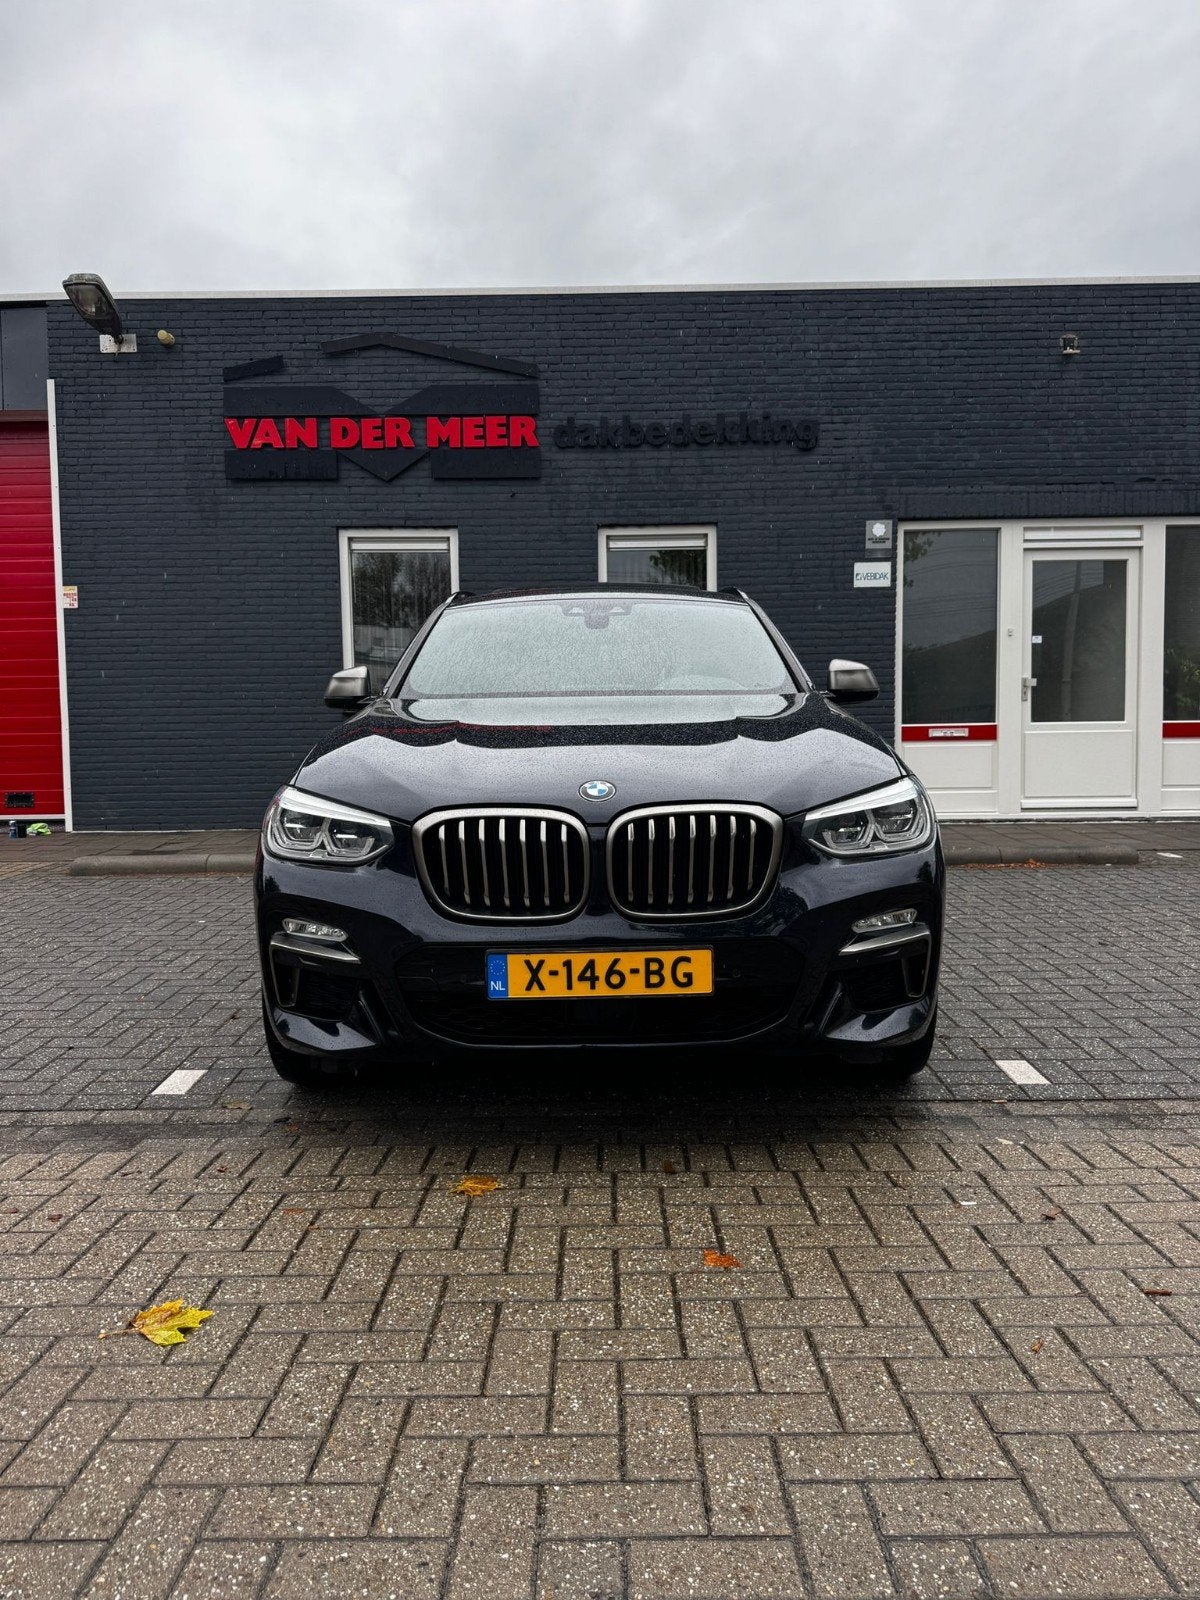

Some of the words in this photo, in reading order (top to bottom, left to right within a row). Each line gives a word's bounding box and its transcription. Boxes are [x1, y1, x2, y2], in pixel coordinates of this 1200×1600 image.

[224, 417, 317, 449] VAN
[330, 417, 415, 449] DER
[426, 416, 540, 448] MEER
[553, 412, 820, 451] dakbedekking
[490, 980, 506, 991] NL
[523, 956, 694, 991] X-146-BG
